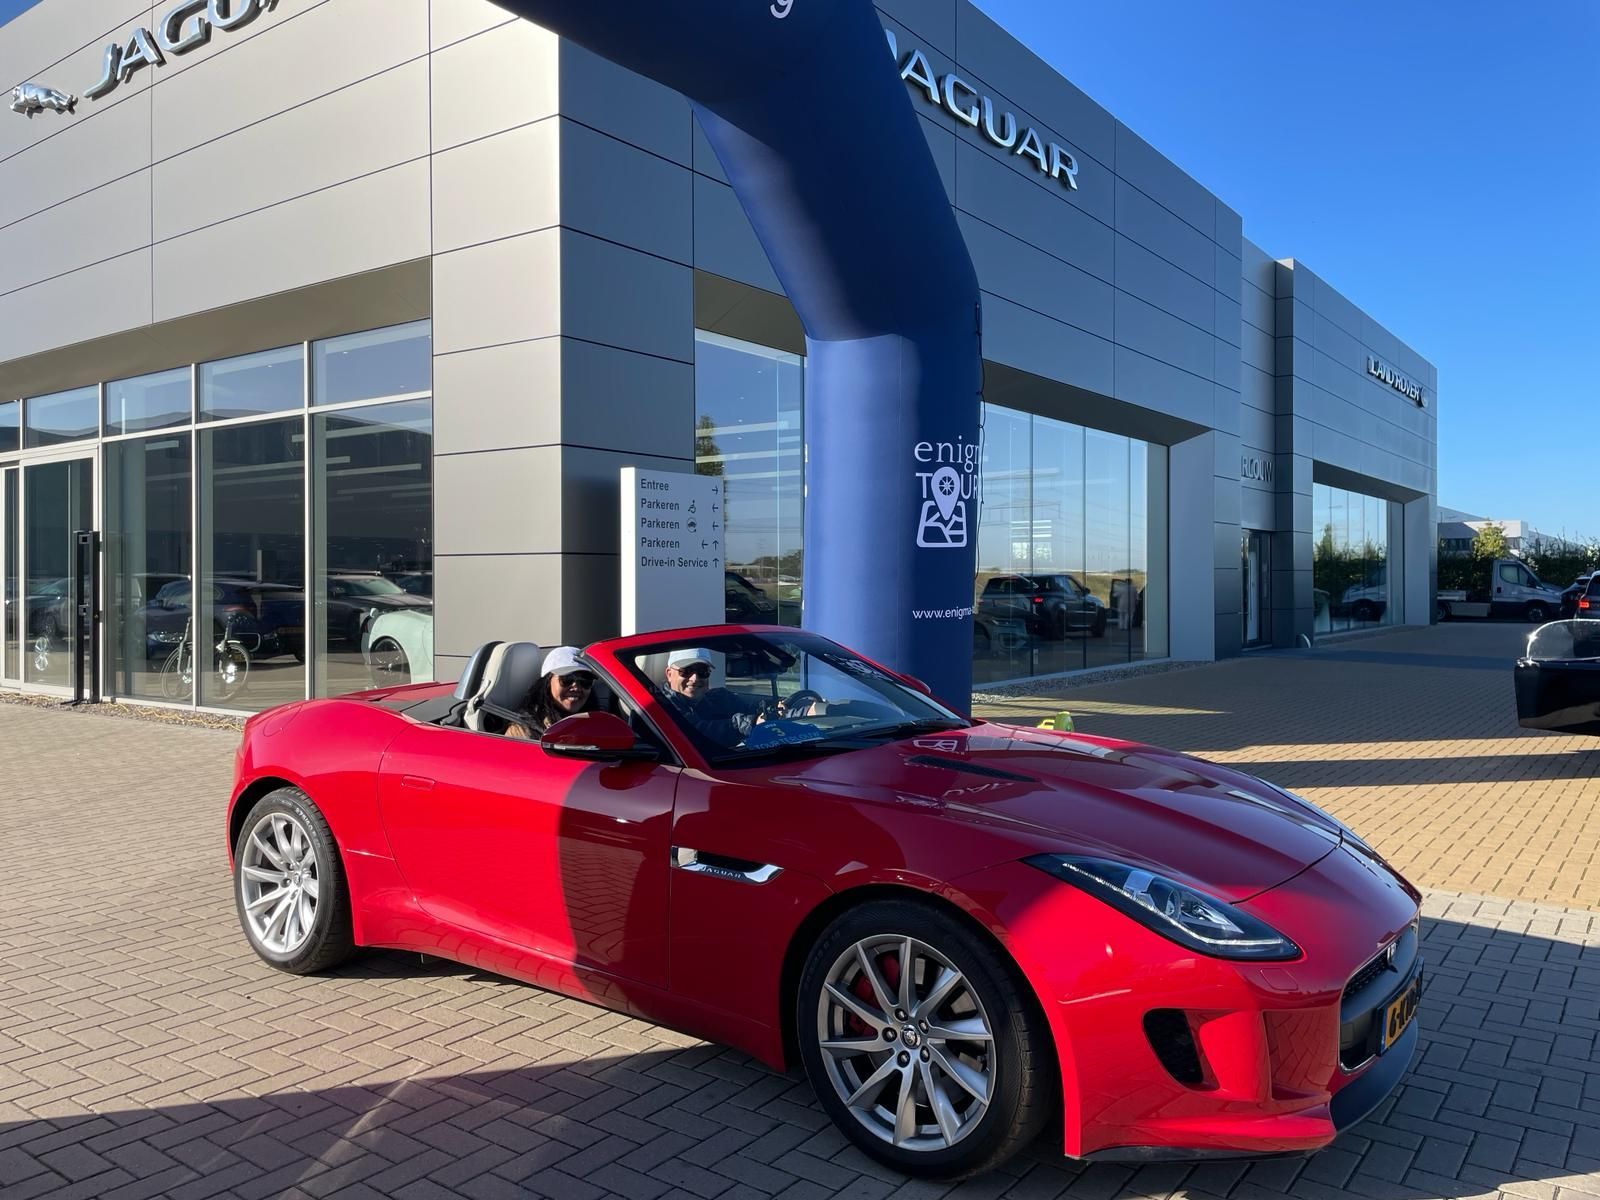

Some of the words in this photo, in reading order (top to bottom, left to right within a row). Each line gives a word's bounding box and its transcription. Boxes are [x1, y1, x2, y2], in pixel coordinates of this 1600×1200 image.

[84, 0, 267, 98] JAGU
[641, 478, 669, 491] Entree
[641, 498, 680, 511] Parkeren
[641, 517, 680, 529] Parkeren
[641, 537, 680, 549] Parkeren
[641, 556, 675, 567] Drive-in
[678, 557, 709, 568] Service
